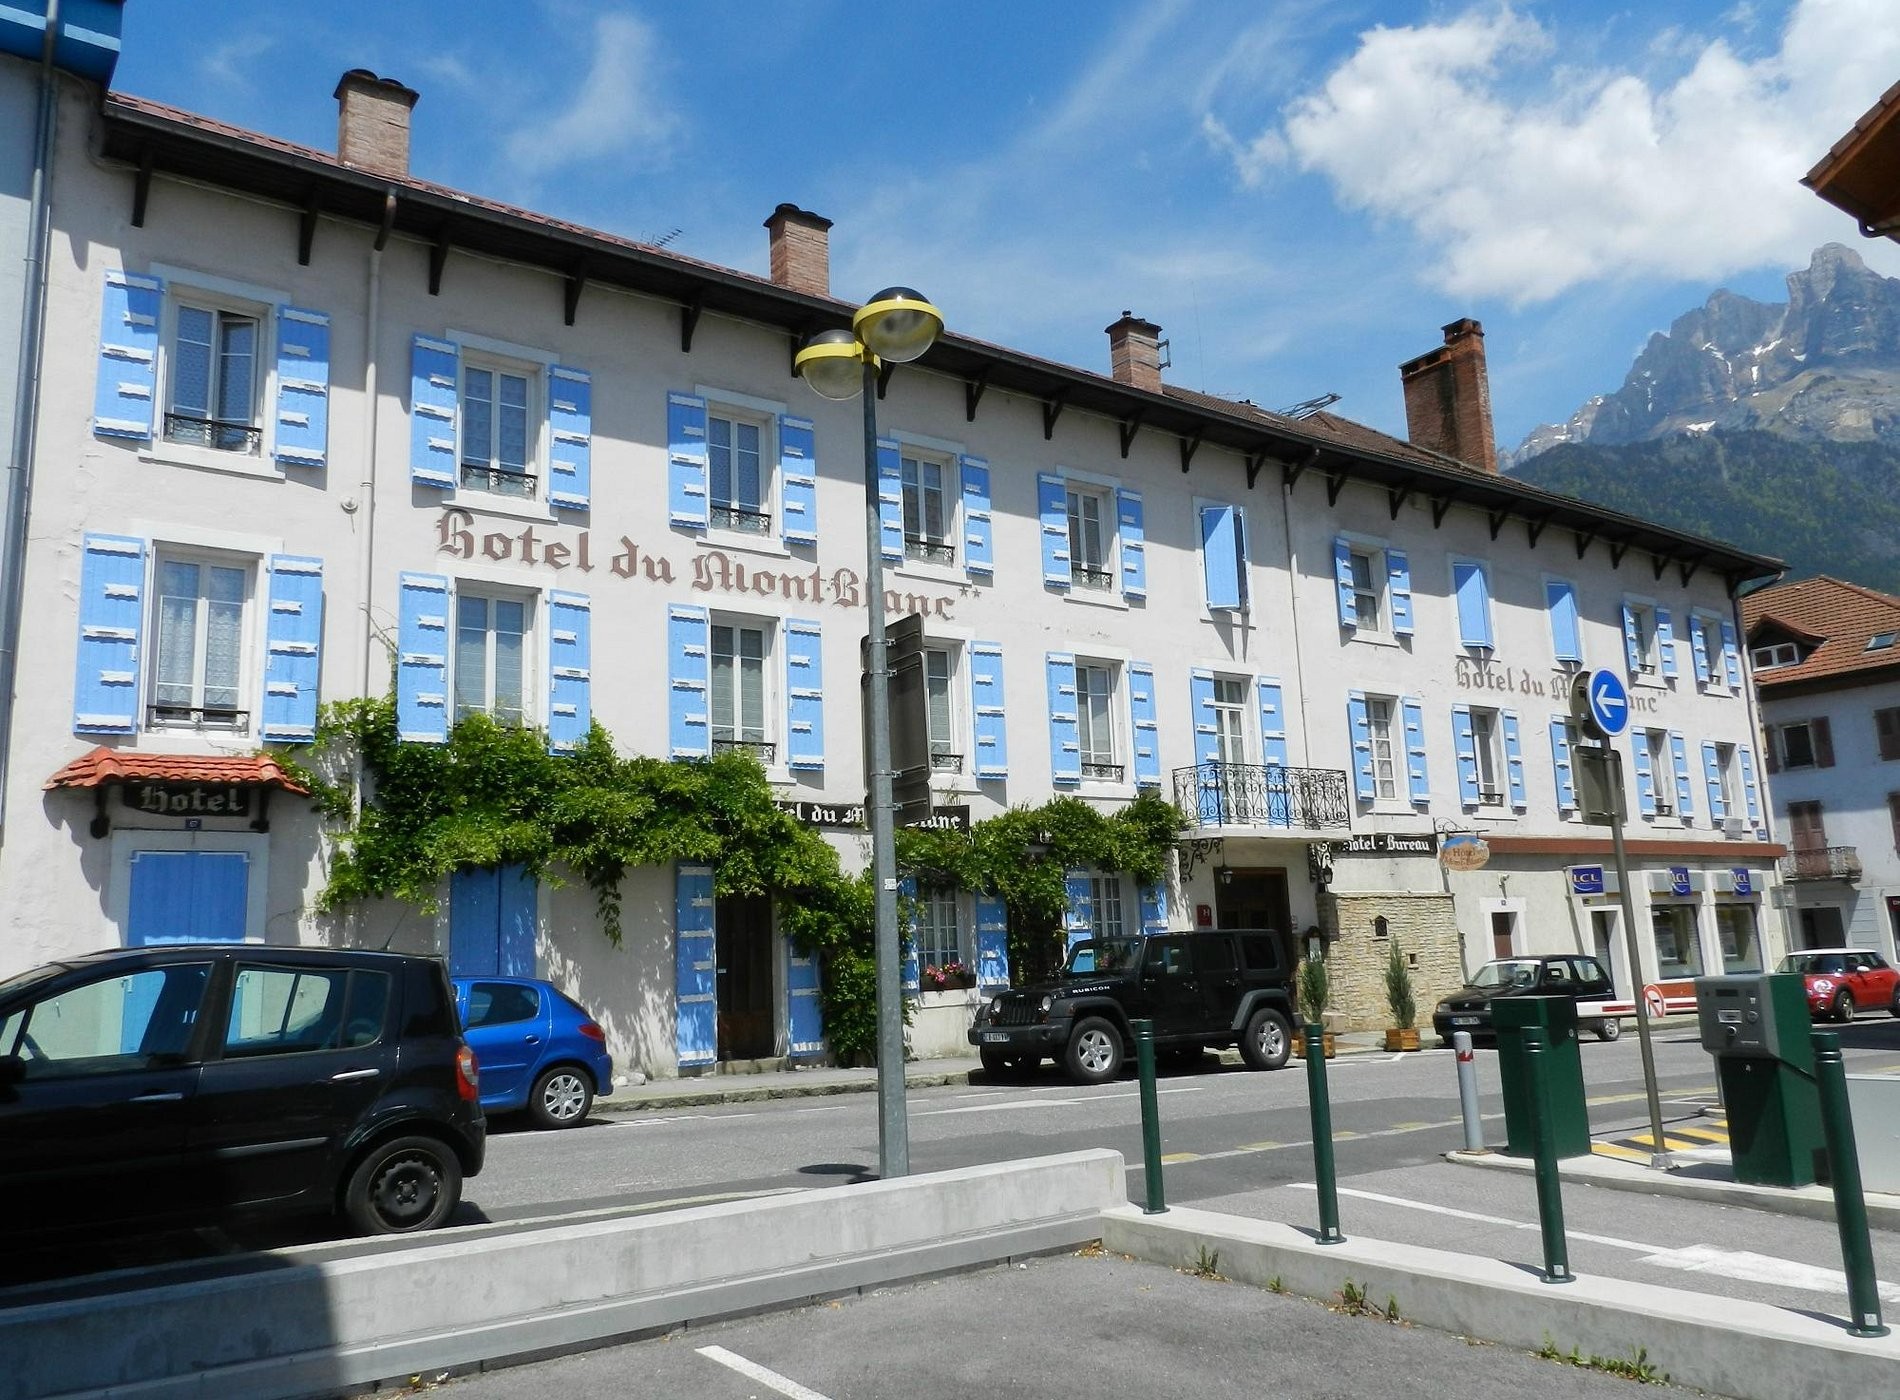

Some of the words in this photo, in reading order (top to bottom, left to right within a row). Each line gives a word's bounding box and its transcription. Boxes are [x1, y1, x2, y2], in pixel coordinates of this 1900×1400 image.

[436, 508, 595, 573] Hotel
[610, 535, 677, 584] du
[691, 551, 826, 604] Mont
[829, 567, 955, 621] Banc
[1520, 668, 1545, 696] du
[141, 787, 243, 812] Hotel
[811, 804, 837, 823] du
[1386, 834, 1430, 851] Bureau
[1573, 873, 1600, 882] LCL
[1072, 985, 1110, 994] RUBICON
